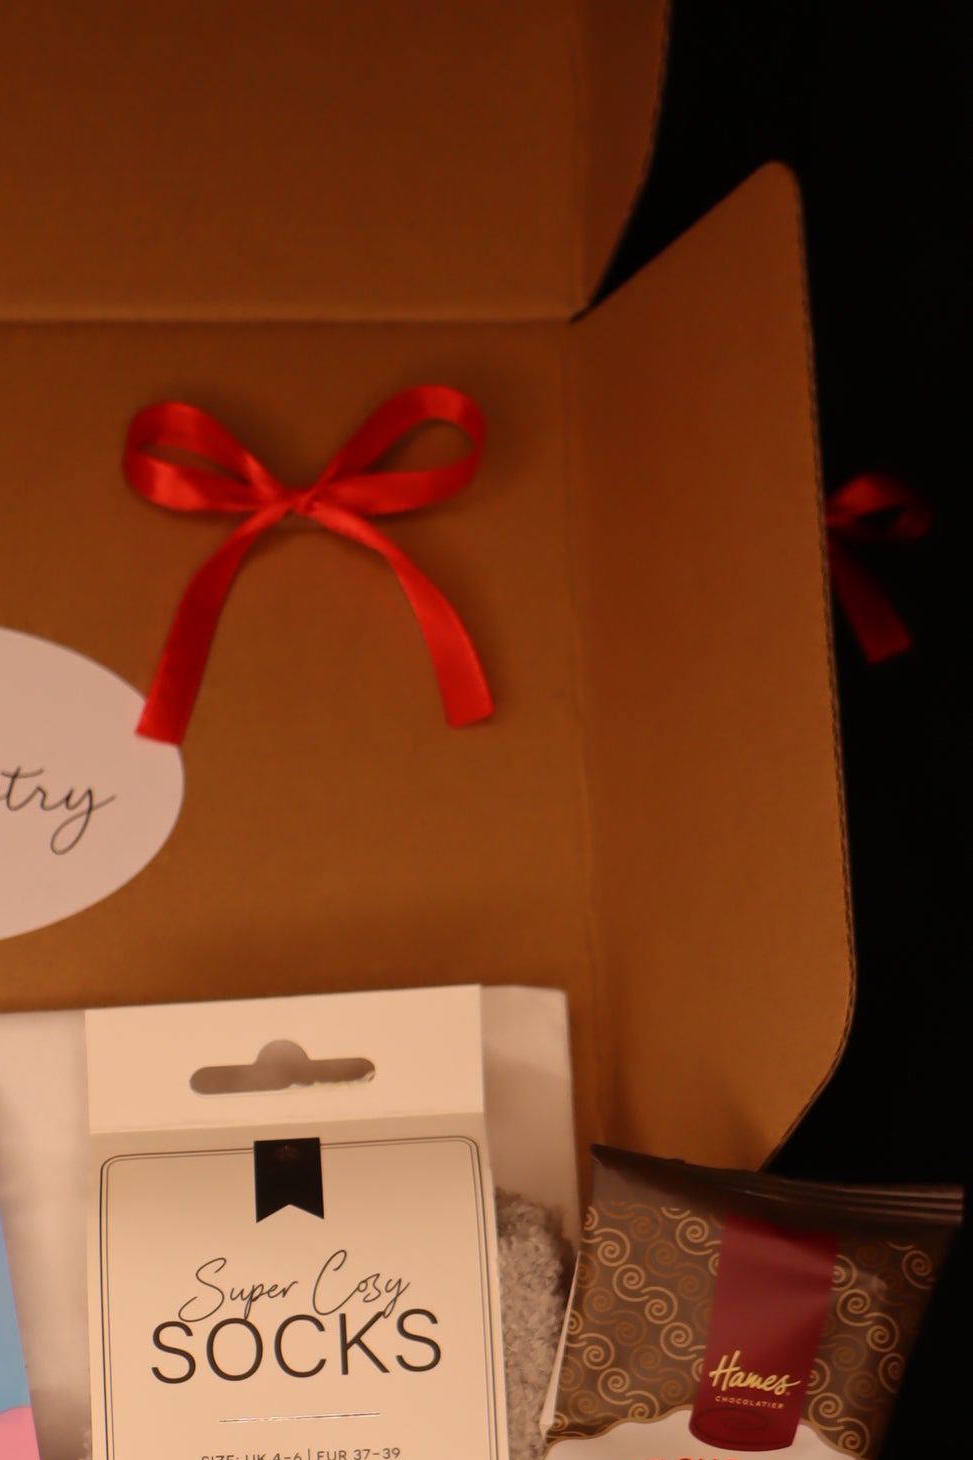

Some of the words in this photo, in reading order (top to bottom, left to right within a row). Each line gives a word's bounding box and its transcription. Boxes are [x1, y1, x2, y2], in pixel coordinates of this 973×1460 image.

[178, 1257, 298, 1323] Super
[312, 1250, 411, 1319] Cozy
[151, 1308, 442, 1385] SOCKS
[708, 1350, 801, 1395] Hames
[715, 1396, 784, 1409] CHOCOLATIER
[353, 1447, 401, 1460] 37-39
